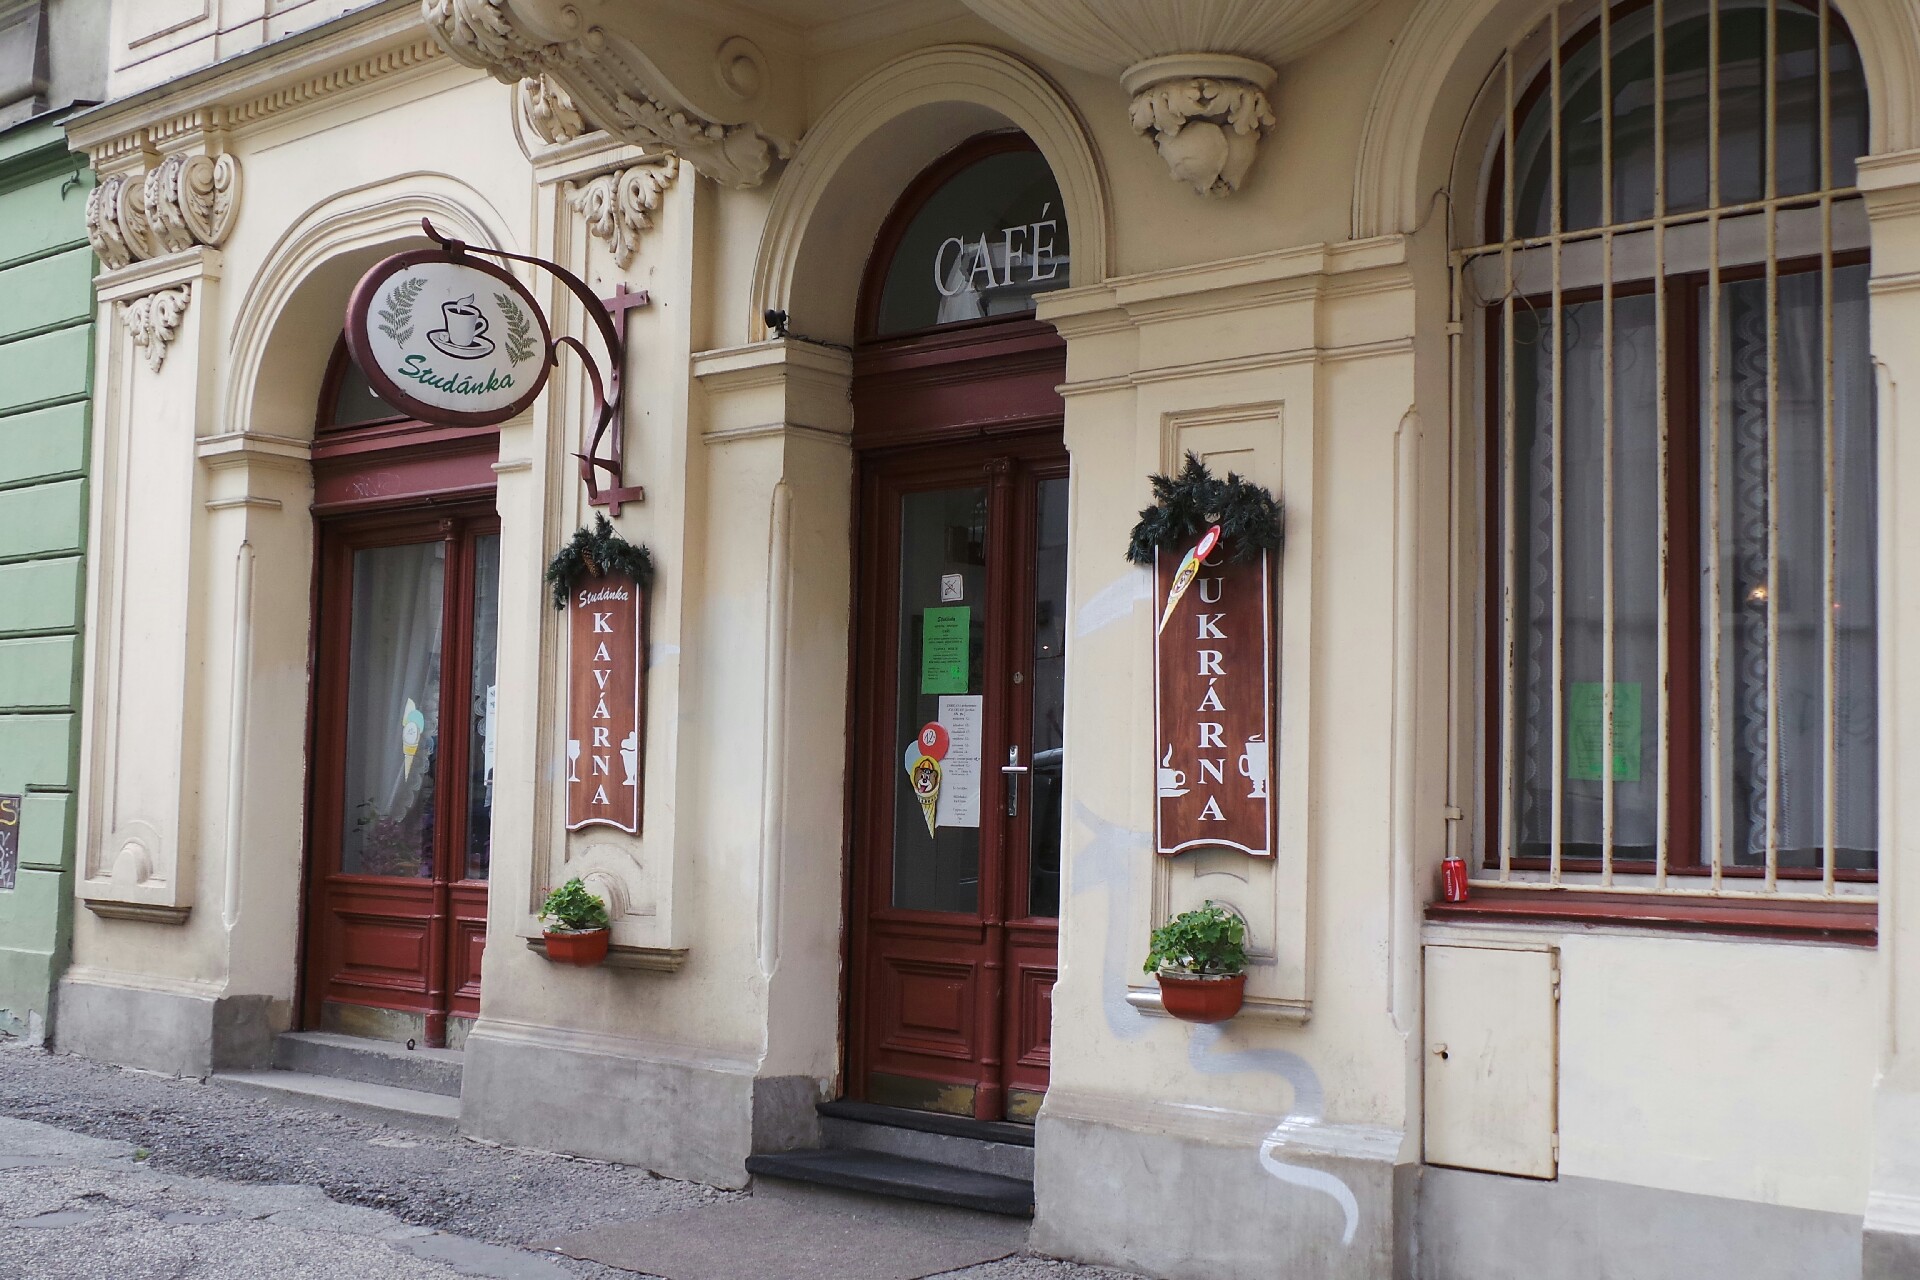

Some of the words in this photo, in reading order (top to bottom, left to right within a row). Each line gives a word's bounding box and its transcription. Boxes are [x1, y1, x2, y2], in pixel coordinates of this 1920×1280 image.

[934, 202, 1057, 297] CAFÉ
[398, 354, 515, 396] Studánka
[578, 585, 629, 608] Studánka
[591, 612, 614, 806] KAVÁRNA
